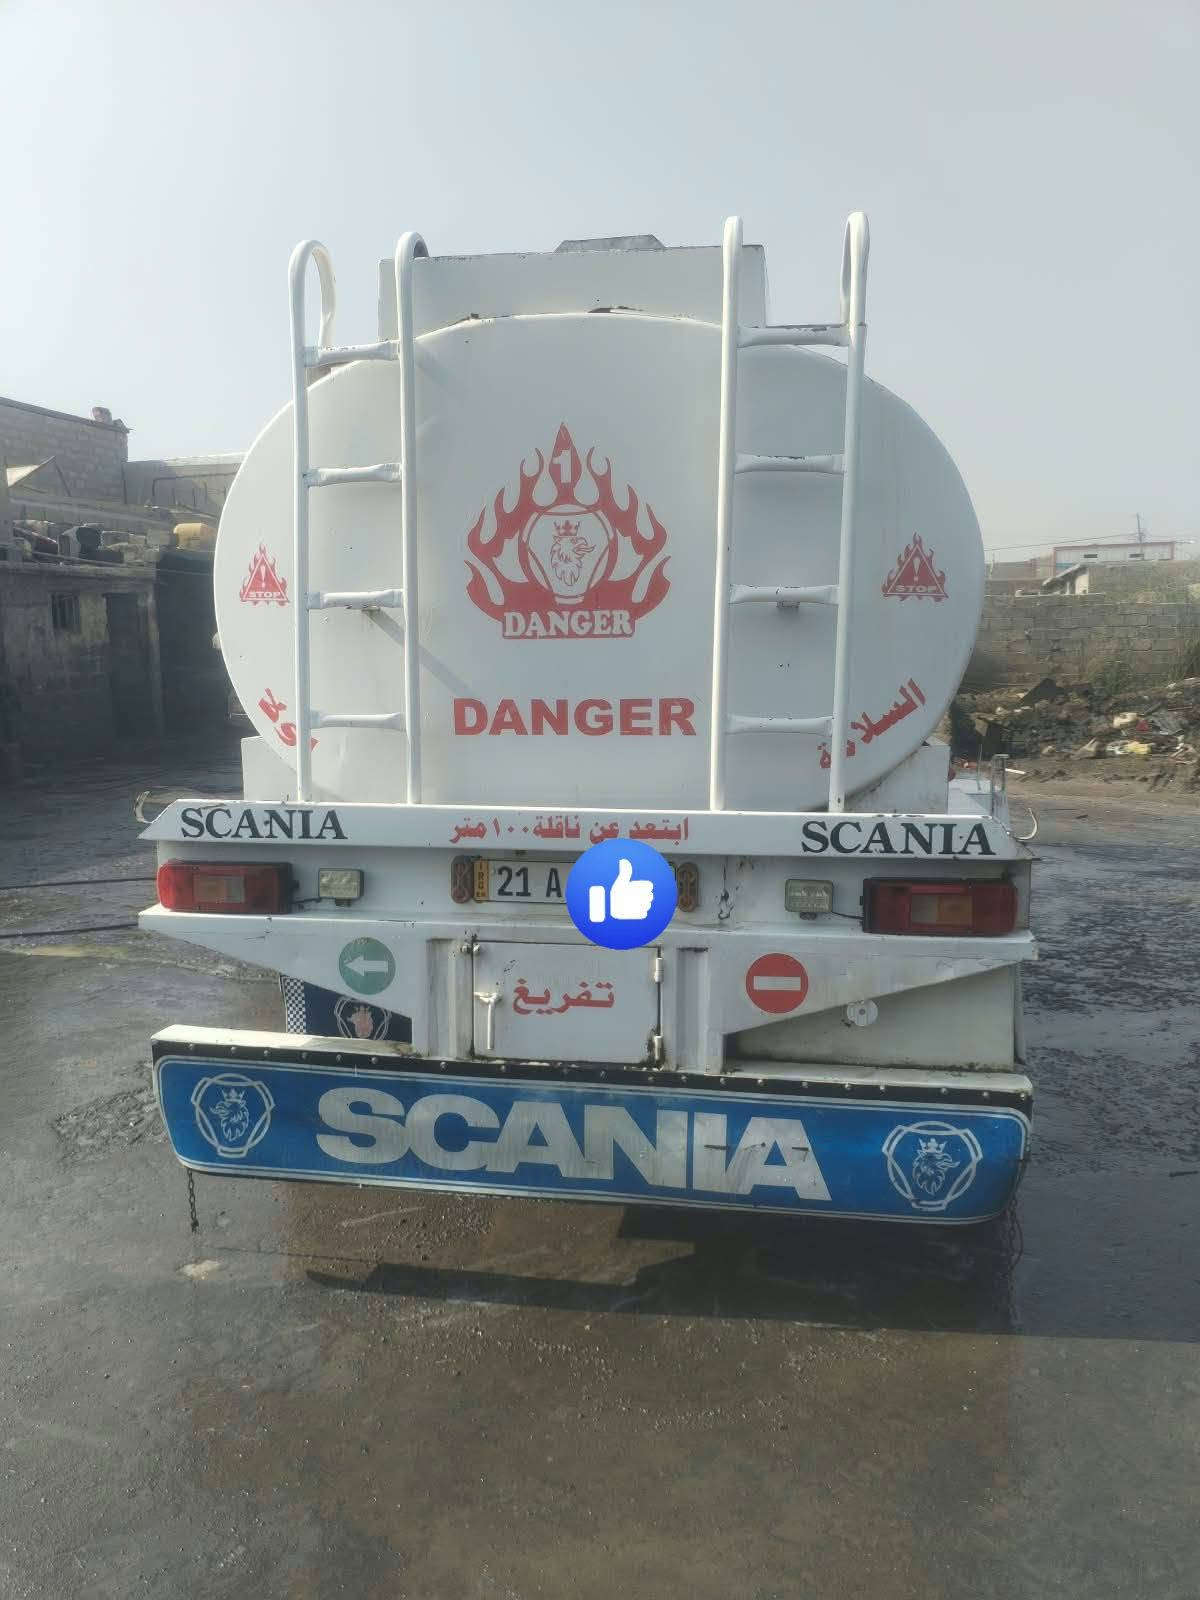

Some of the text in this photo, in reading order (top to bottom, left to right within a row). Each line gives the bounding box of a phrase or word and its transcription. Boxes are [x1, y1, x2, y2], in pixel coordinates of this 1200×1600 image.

[552, 450, 572, 484] 1
[503, 609, 633, 638] DANGER
[453, 698, 697, 736] DANGER
[181, 807, 348, 841] SCANIA
[629, 816, 689, 846] ابتعد
[801, 820, 997, 857] SCANIA
[497, 865, 562, 898] 21 A
[513, 978, 616, 1015] تفريغ
[316, 1087, 832, 1201] SCANIA
